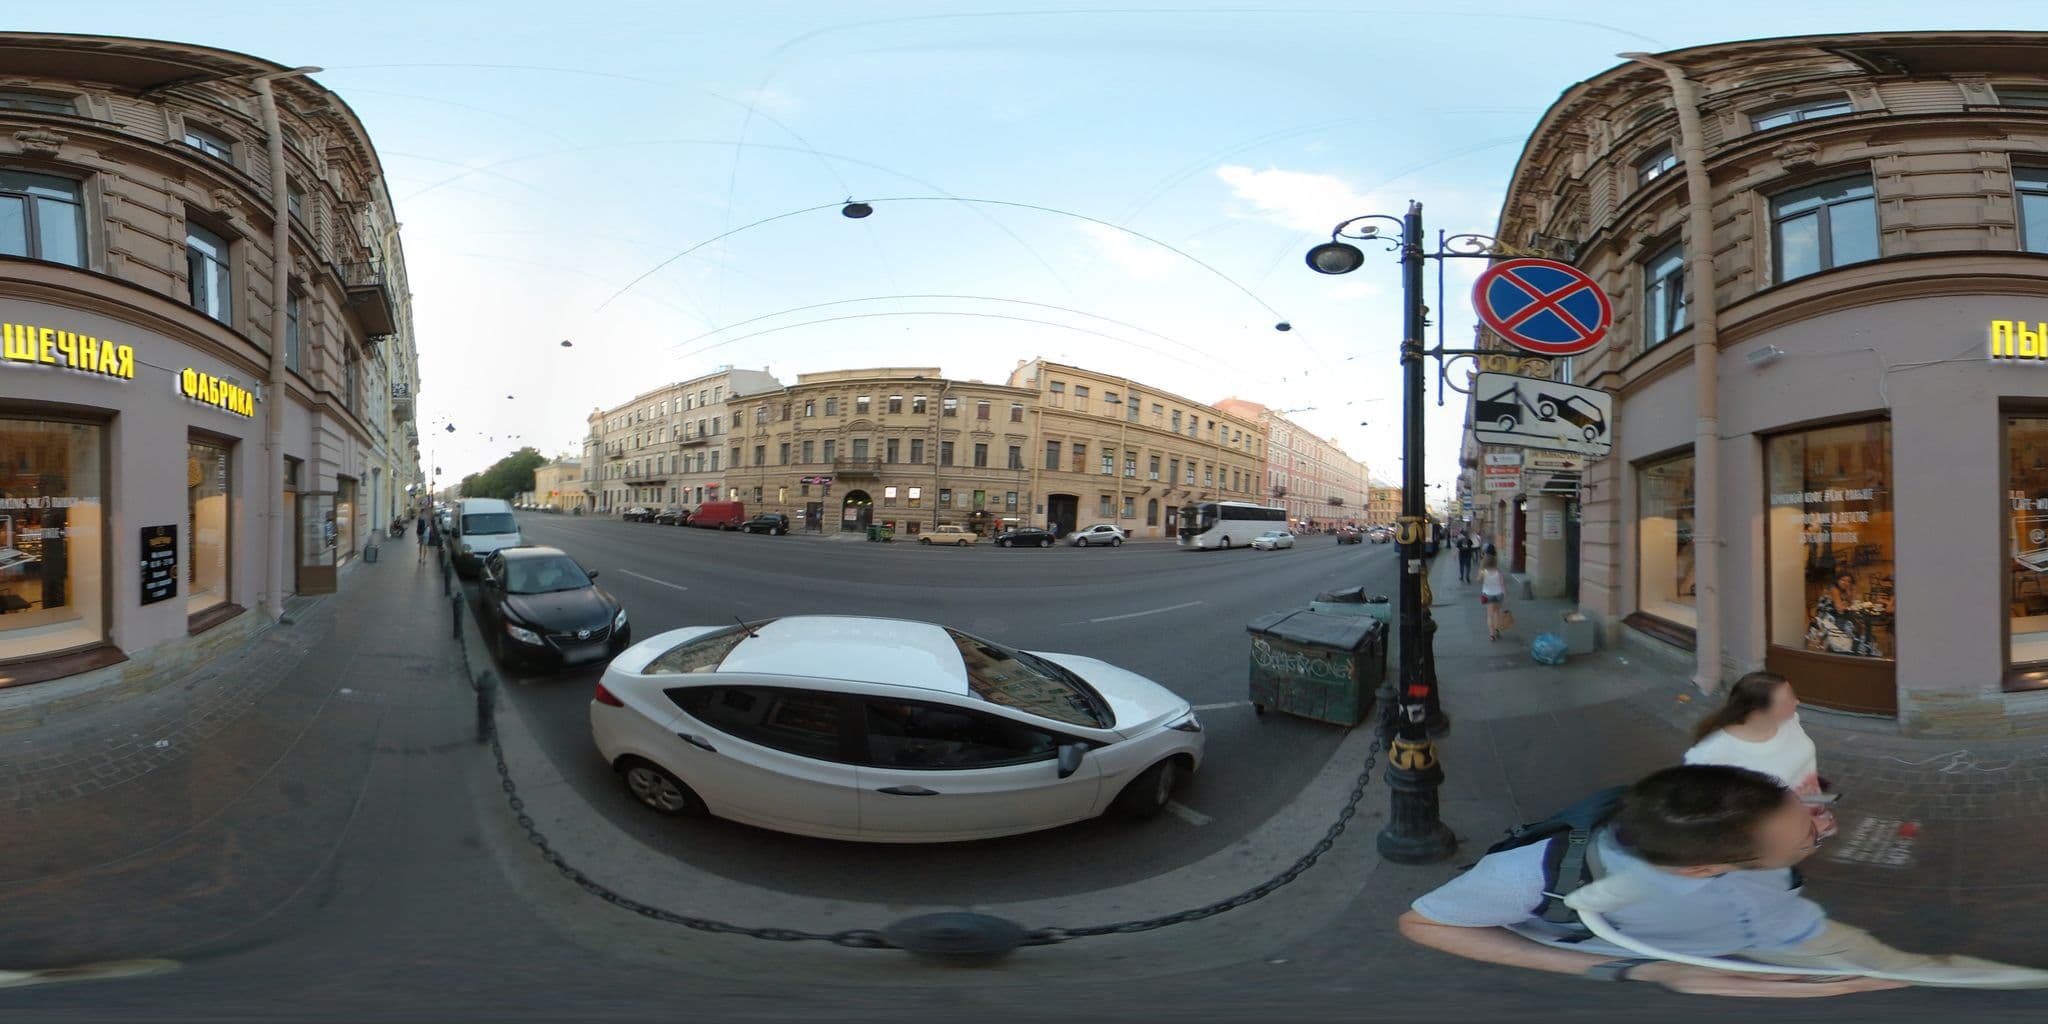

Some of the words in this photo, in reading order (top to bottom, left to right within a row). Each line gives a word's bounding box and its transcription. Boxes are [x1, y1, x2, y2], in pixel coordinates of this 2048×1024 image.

[3, 323, 135, 379] ШЕЧНАЯ
[181, 367, 254, 417] ФАБРИКА
[1991, 320, 2047, 358] ПЫ
